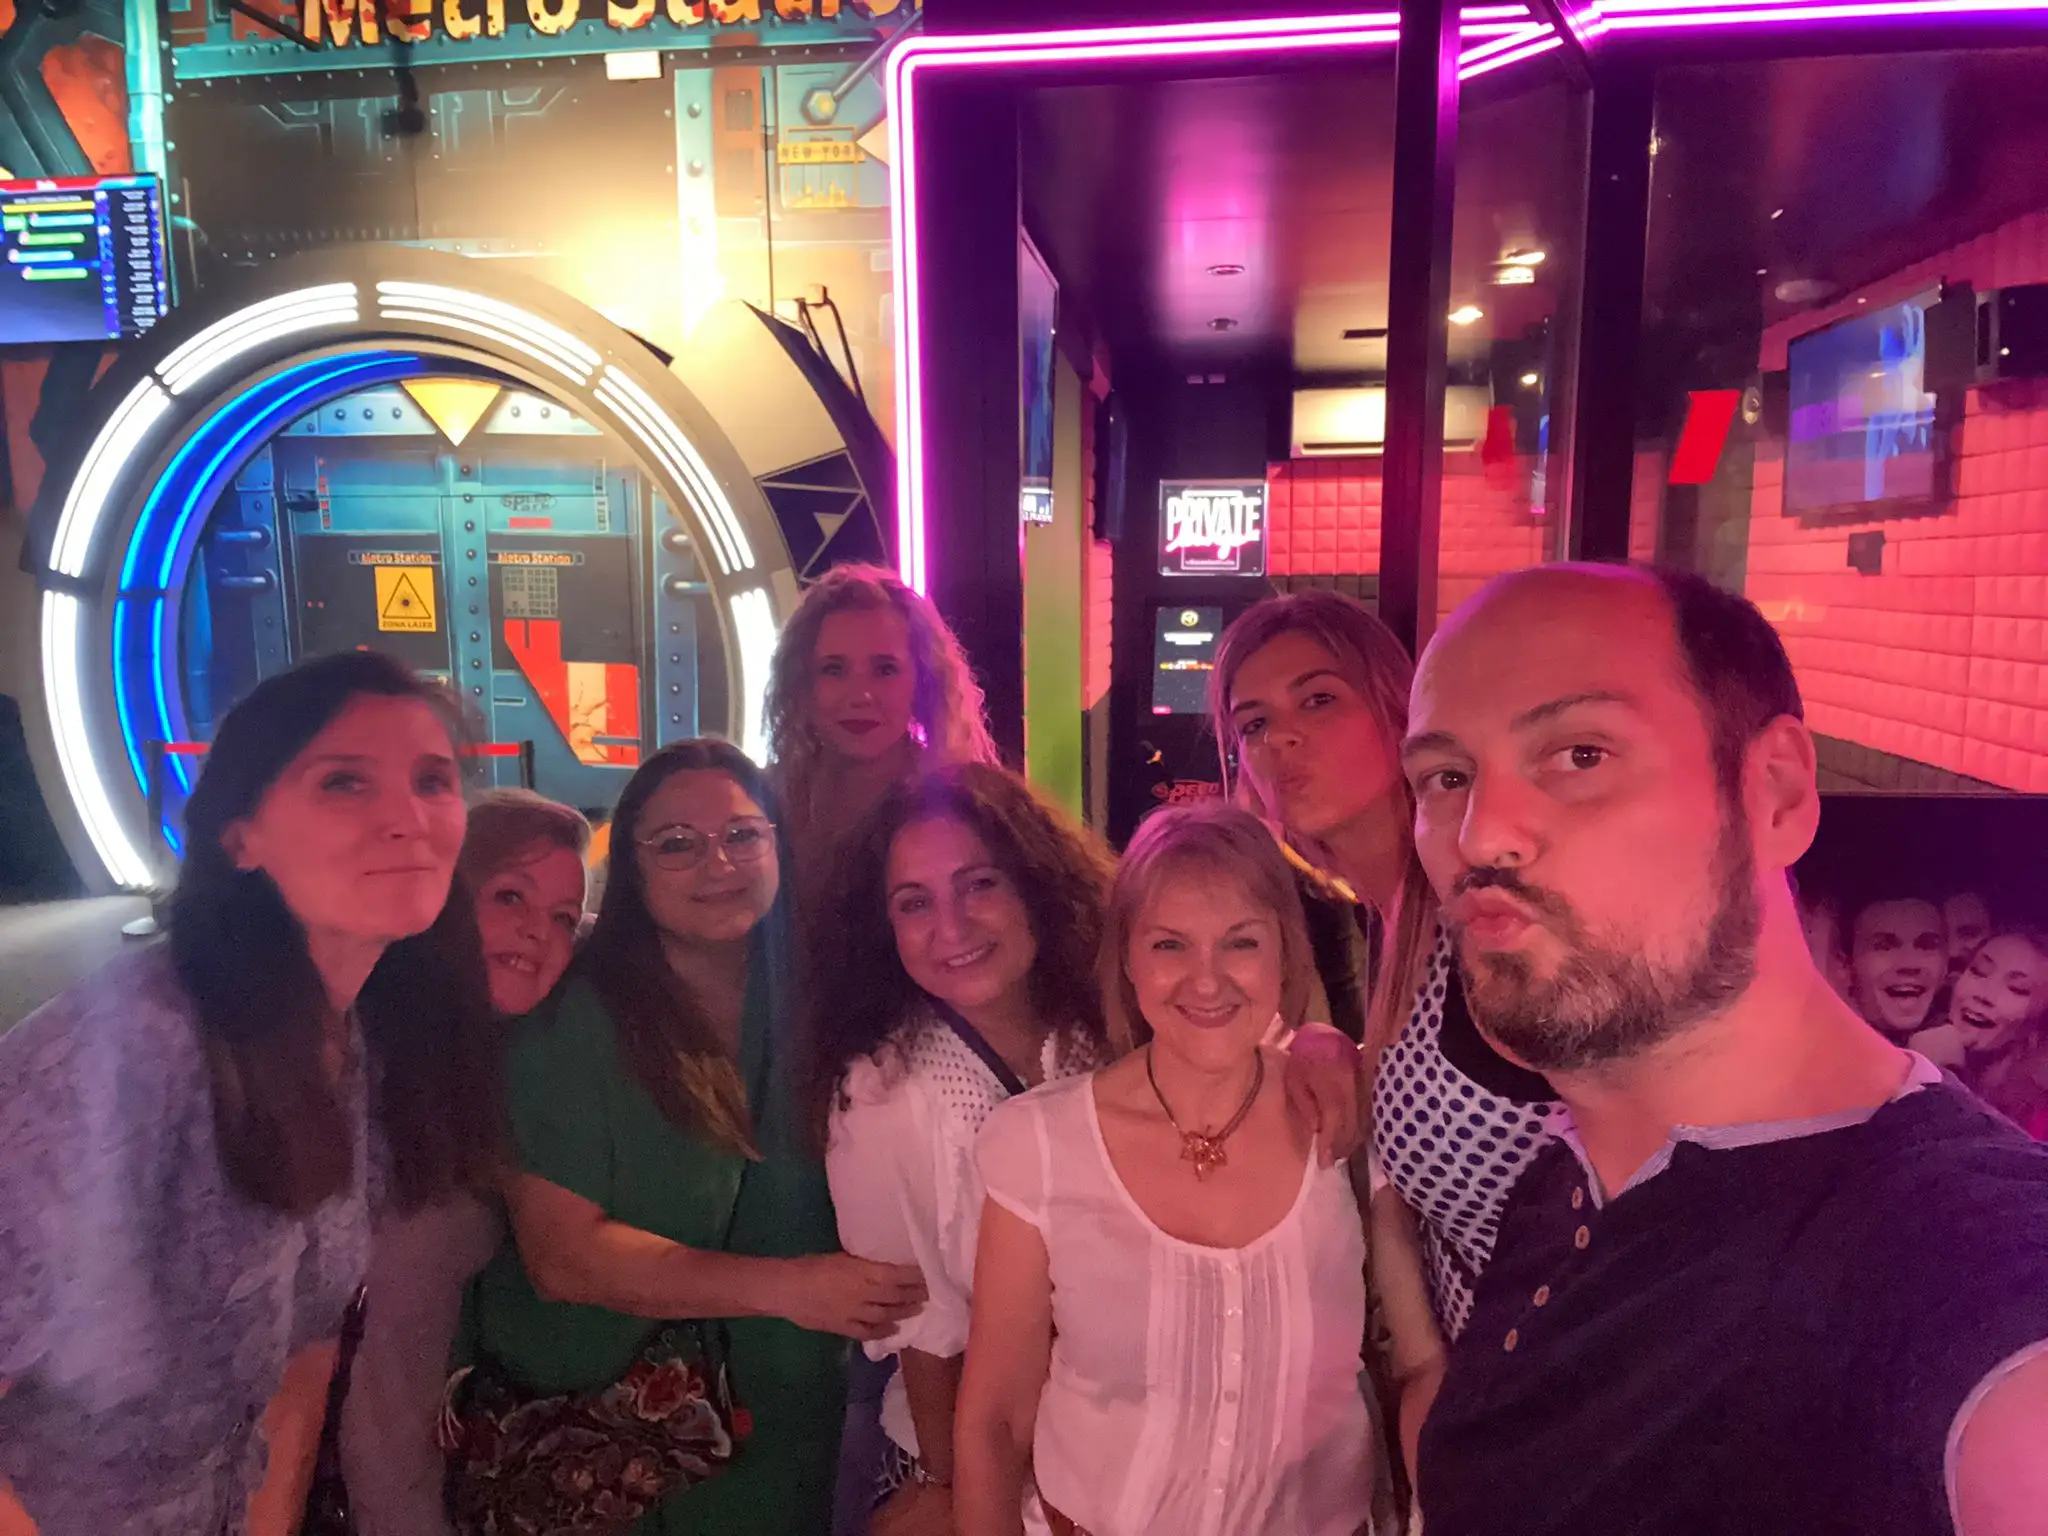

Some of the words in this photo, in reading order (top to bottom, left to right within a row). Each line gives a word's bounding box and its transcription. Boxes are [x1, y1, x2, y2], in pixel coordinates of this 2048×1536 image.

[781, 145, 812, 160] NEW
[821, 144, 860, 160] YOR
[1166, 497, 1262, 542] PRIVATE
[361, 552, 393, 565] Metro
[394, 552, 432, 565] Station
[497, 551, 530, 565] Metro
[531, 552, 573, 565] Station
[382, 621, 406, 630] ZONA
